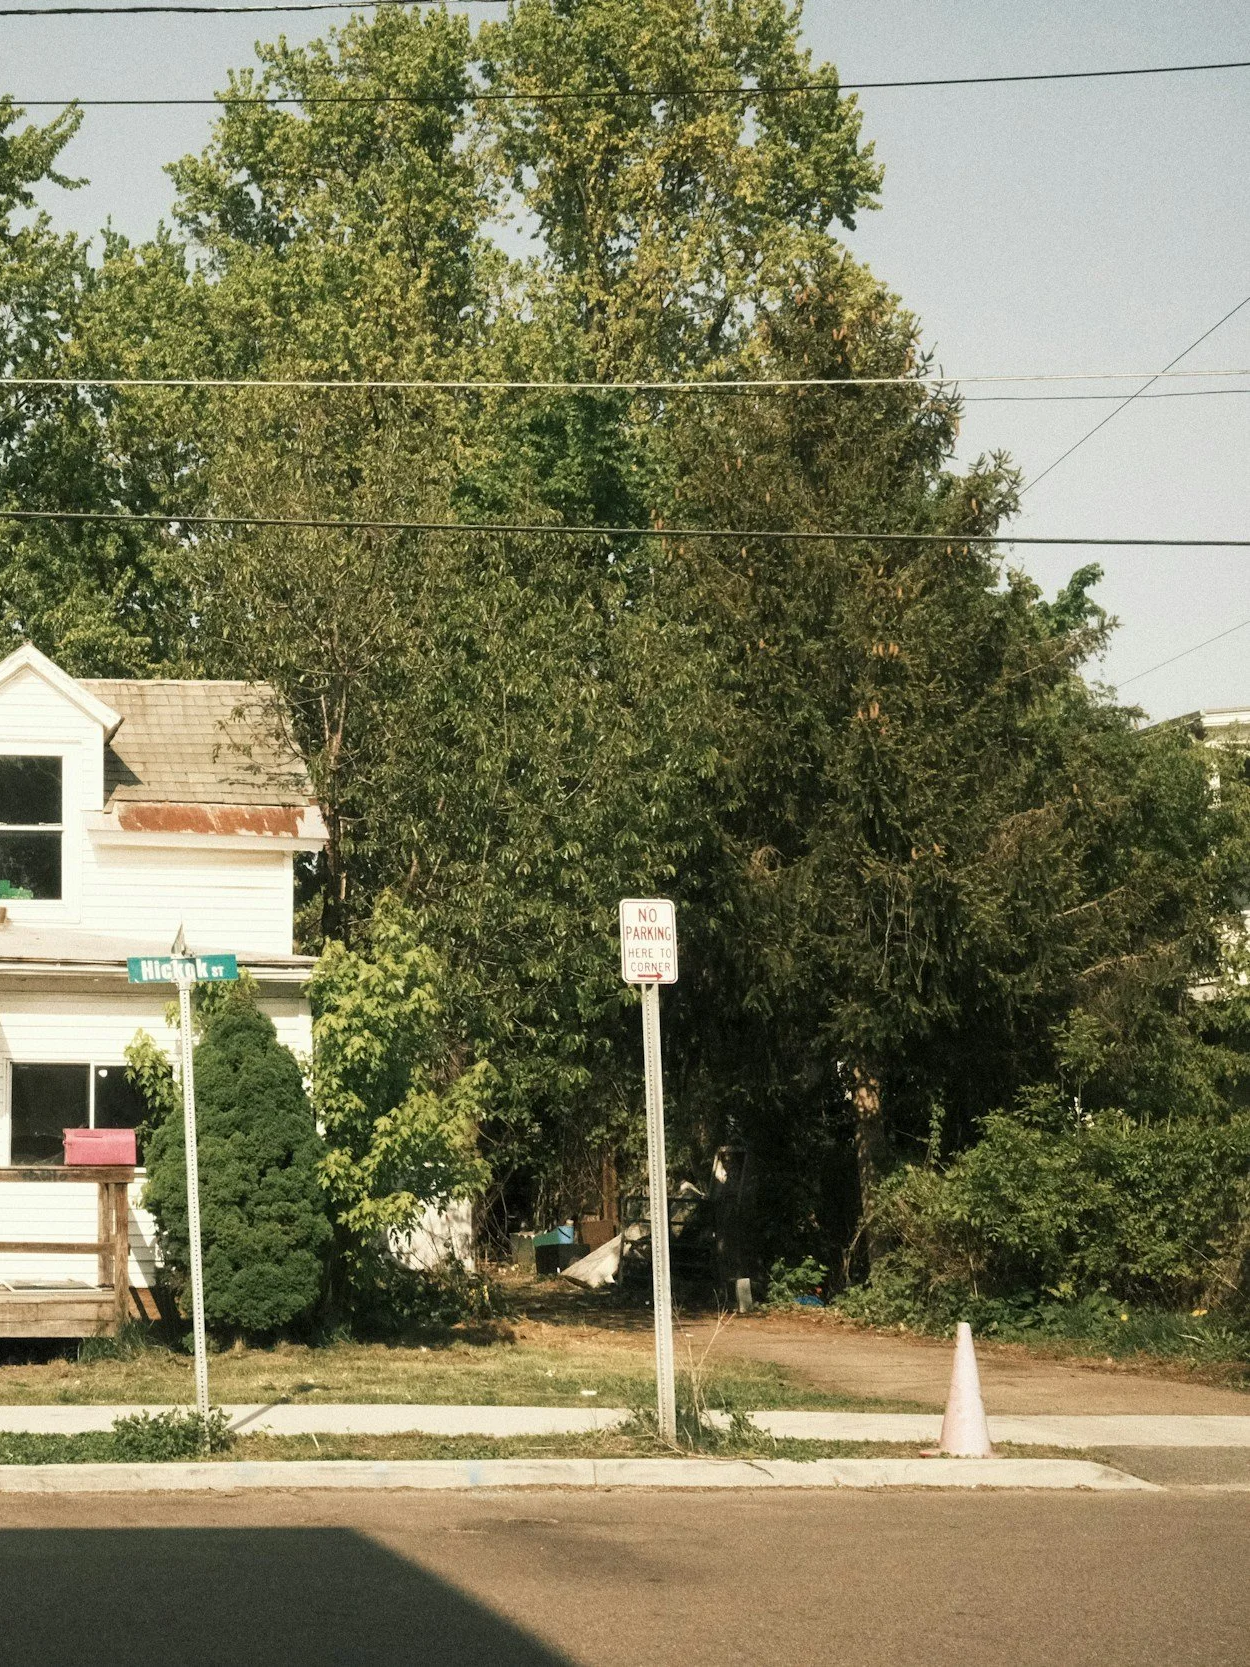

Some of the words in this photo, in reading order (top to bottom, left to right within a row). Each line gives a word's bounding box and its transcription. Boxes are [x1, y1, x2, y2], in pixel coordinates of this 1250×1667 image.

[638, 908, 657, 922] NO
[626, 926, 671, 940] PARKING
[628, 948, 654, 958] HERE
[660, 948, 672, 959] TO
[140, 958, 209, 981] Hickok
[211, 965, 225, 978] ST
[630, 962, 671, 972] CORNER
